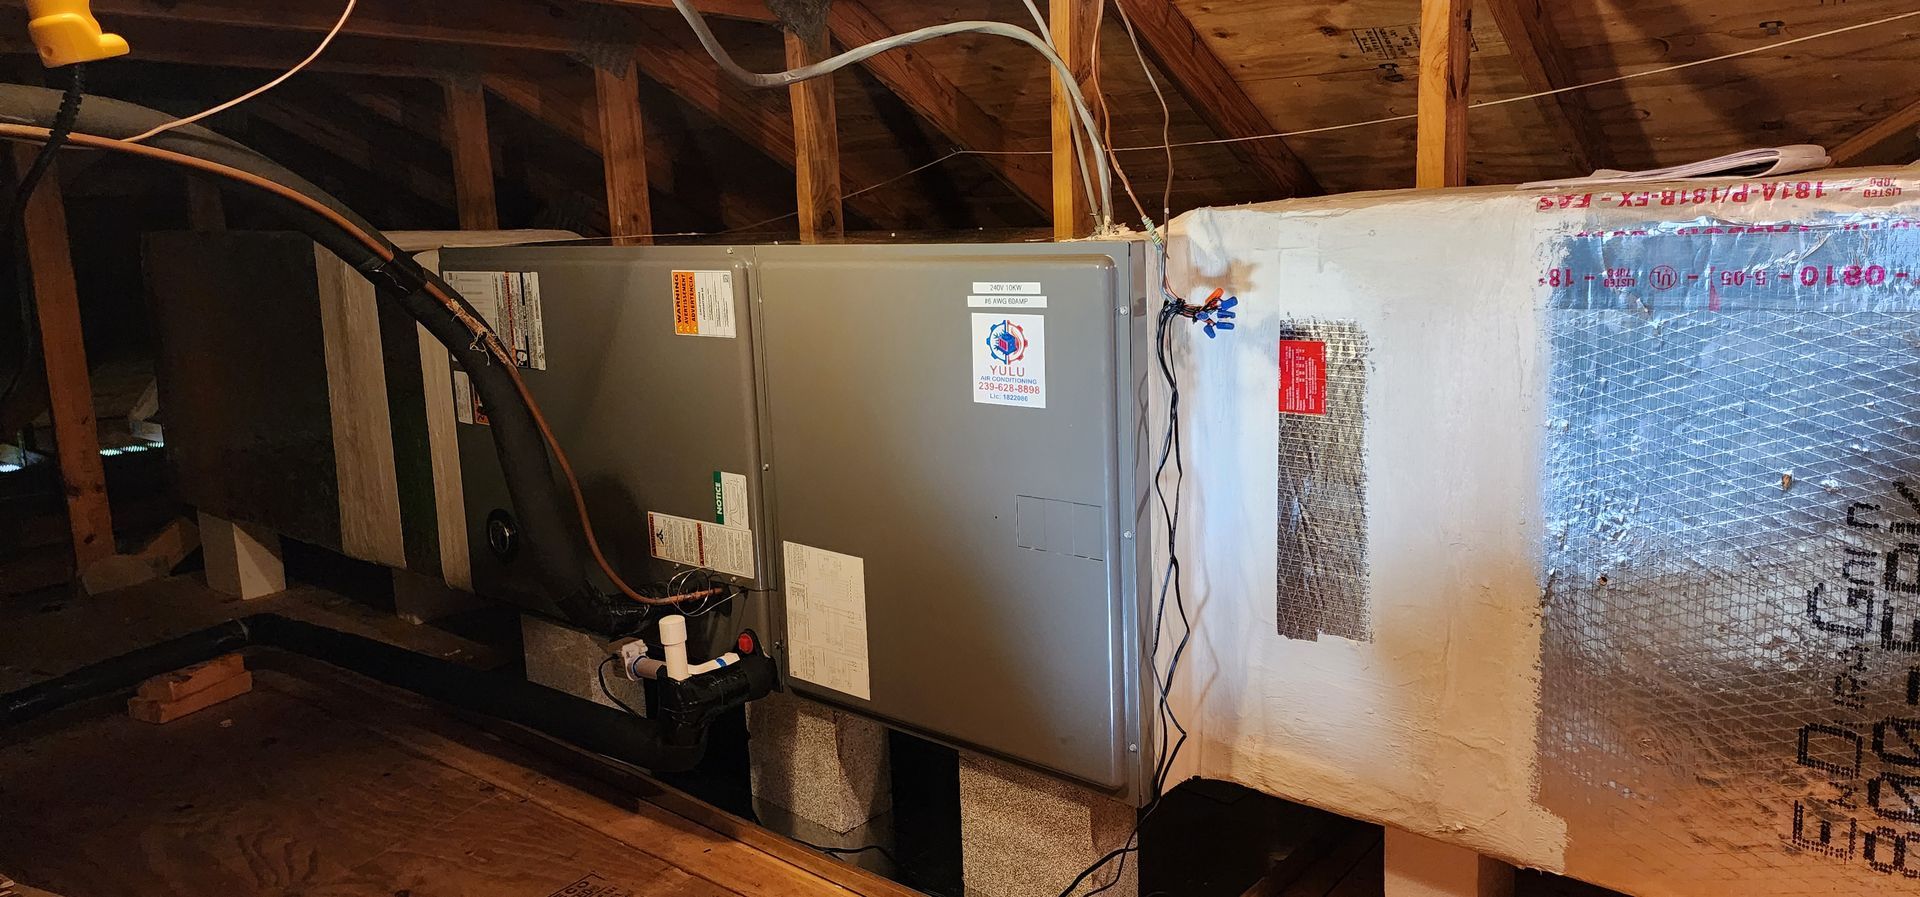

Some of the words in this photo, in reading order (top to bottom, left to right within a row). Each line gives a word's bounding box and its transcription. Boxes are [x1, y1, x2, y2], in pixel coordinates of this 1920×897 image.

[1863, 187, 1902, 199] LISTED
[1603, 278, 1635, 288] LISTED
[674, 274, 682, 323] WARNING
[688, 276, 696, 322] ADVERTENCIA
[992, 297, 1007, 305] AWG
[990, 365, 1025, 377] YULU
[991, 375, 1038, 385] CONDITIONING
[978, 381, 1041, 395] 239-628-8898
[715, 482, 723, 515] NOTICE
